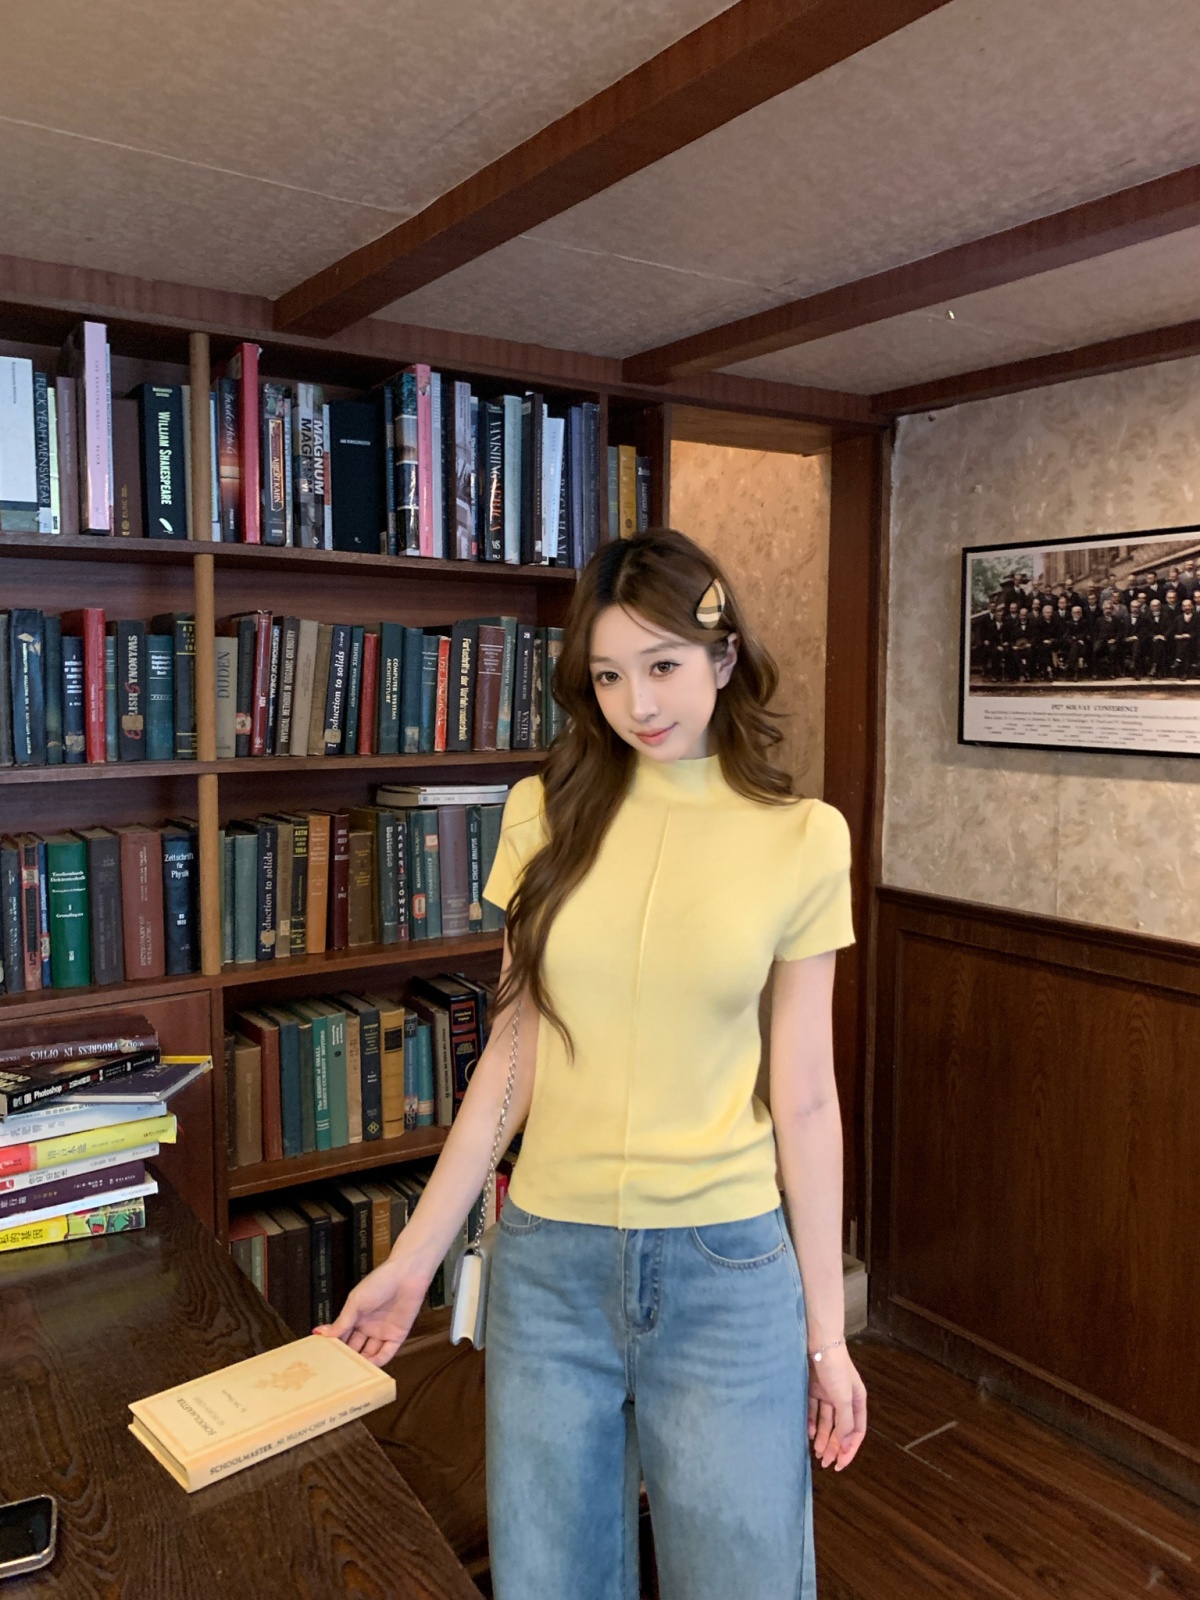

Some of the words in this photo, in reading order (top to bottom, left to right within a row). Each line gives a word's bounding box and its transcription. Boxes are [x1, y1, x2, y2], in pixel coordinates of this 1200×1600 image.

[36, 376, 48, 405] FUCK
[37, 410, 49, 438] YEAH
[313, 420, 324, 495] MAGNUM
[490, 421, 501, 479] VANISHING
[38, 441, 50, 504] MENSWEAR
[286, 629, 295, 658] CHEMISTRY
[217, 651, 230, 698] DUDEN
[285, 659, 294, 684] ORGANIC
[335, 650, 345, 677] solids
[334, 679, 342, 688] to
[461, 676, 469, 686] der
[282, 692, 292, 716] METHODS
[1094, 704, 1139, 713] CONFERENCE
[281, 718, 290, 743] PHYSICAL
[328, 691, 342, 748] Ioduction
[521, 711, 529, 741] CHINA
[164, 853, 194, 862] Zeitschrift
[176, 862, 184, 870] für
[263, 851, 273, 879] solids
[171, 870, 189, 880] Physik
[264, 880, 273, 890] to
[398, 881, 406, 922] TOWNS
[30, 1049, 59, 1060] OPTICS
[63, 1047, 72, 1057] IN
[78, 1042, 118, 1056] PROGRESS
[33, 1083, 63, 1100] Photoshop
[210, 1443, 272, 1476] SCHOOLMASTER
